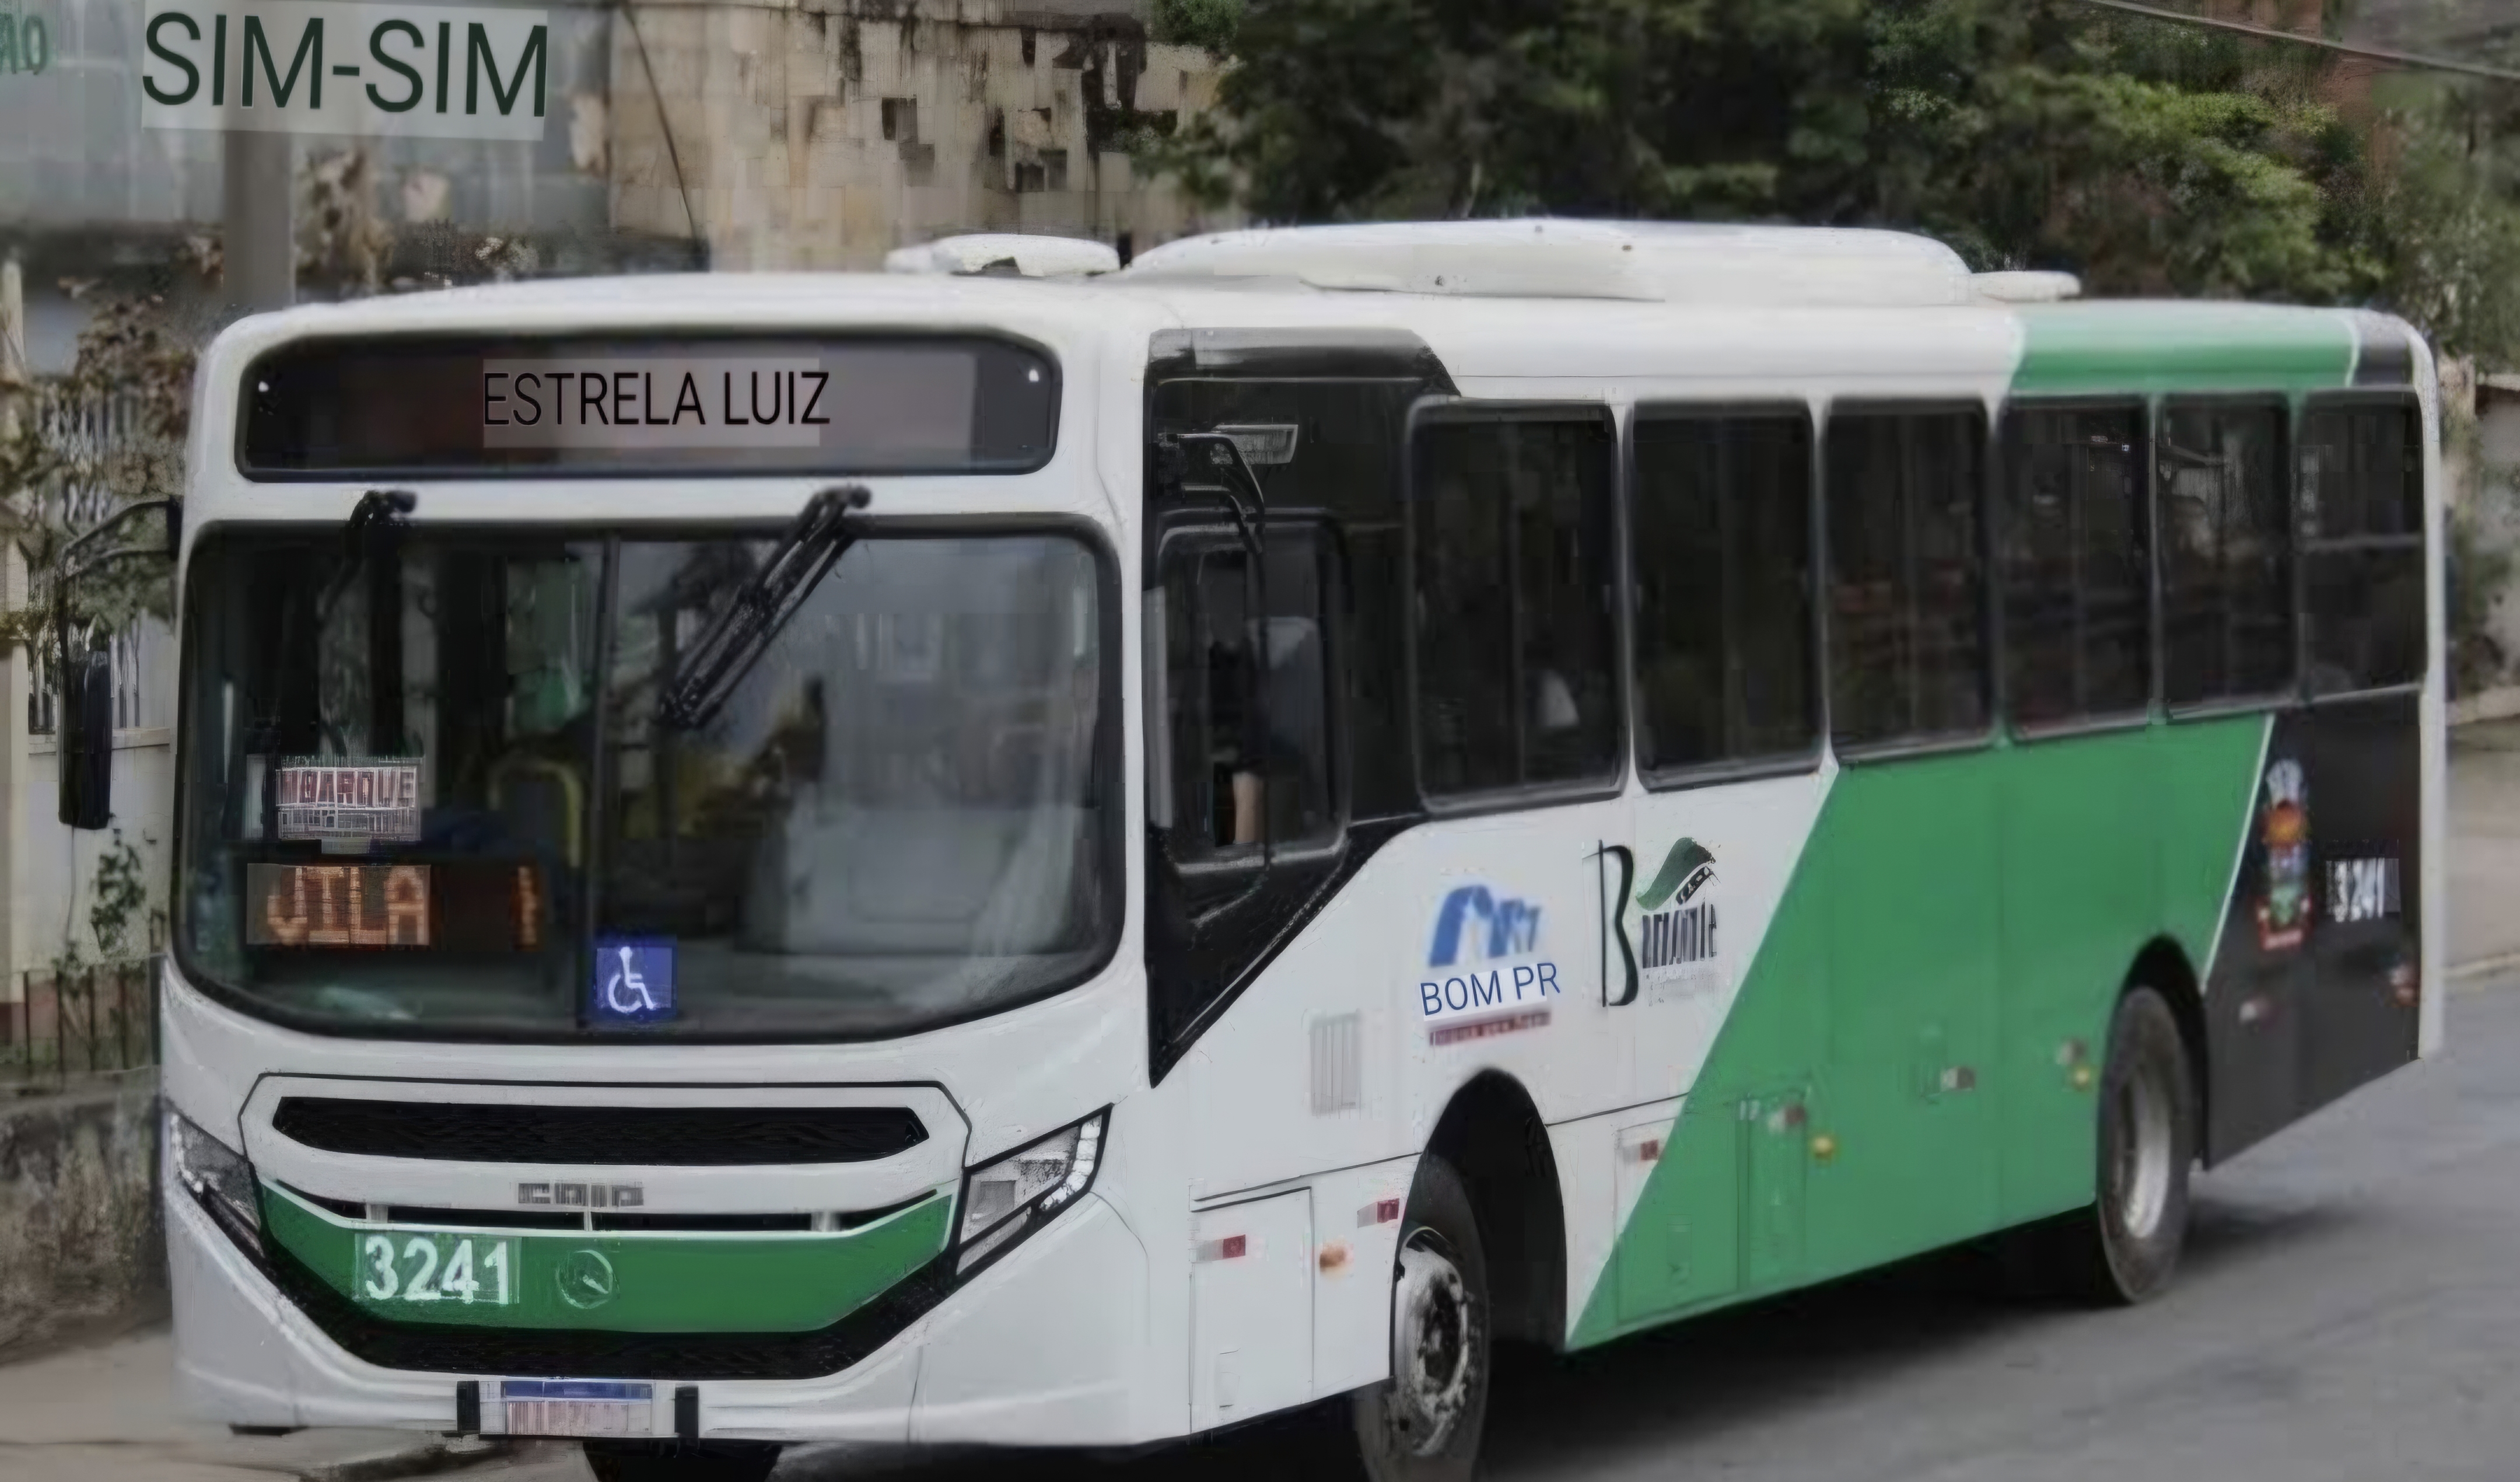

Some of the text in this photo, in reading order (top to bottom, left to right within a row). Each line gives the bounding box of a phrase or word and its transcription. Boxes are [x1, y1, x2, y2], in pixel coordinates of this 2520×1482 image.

[143, 13, 547, 117] SIM-SIM
[484, 372, 830, 426] ESTRELA LUIZ
[1420, 963, 1560, 1016] BOM PR
[365, 1236, 509, 1305] 3241
